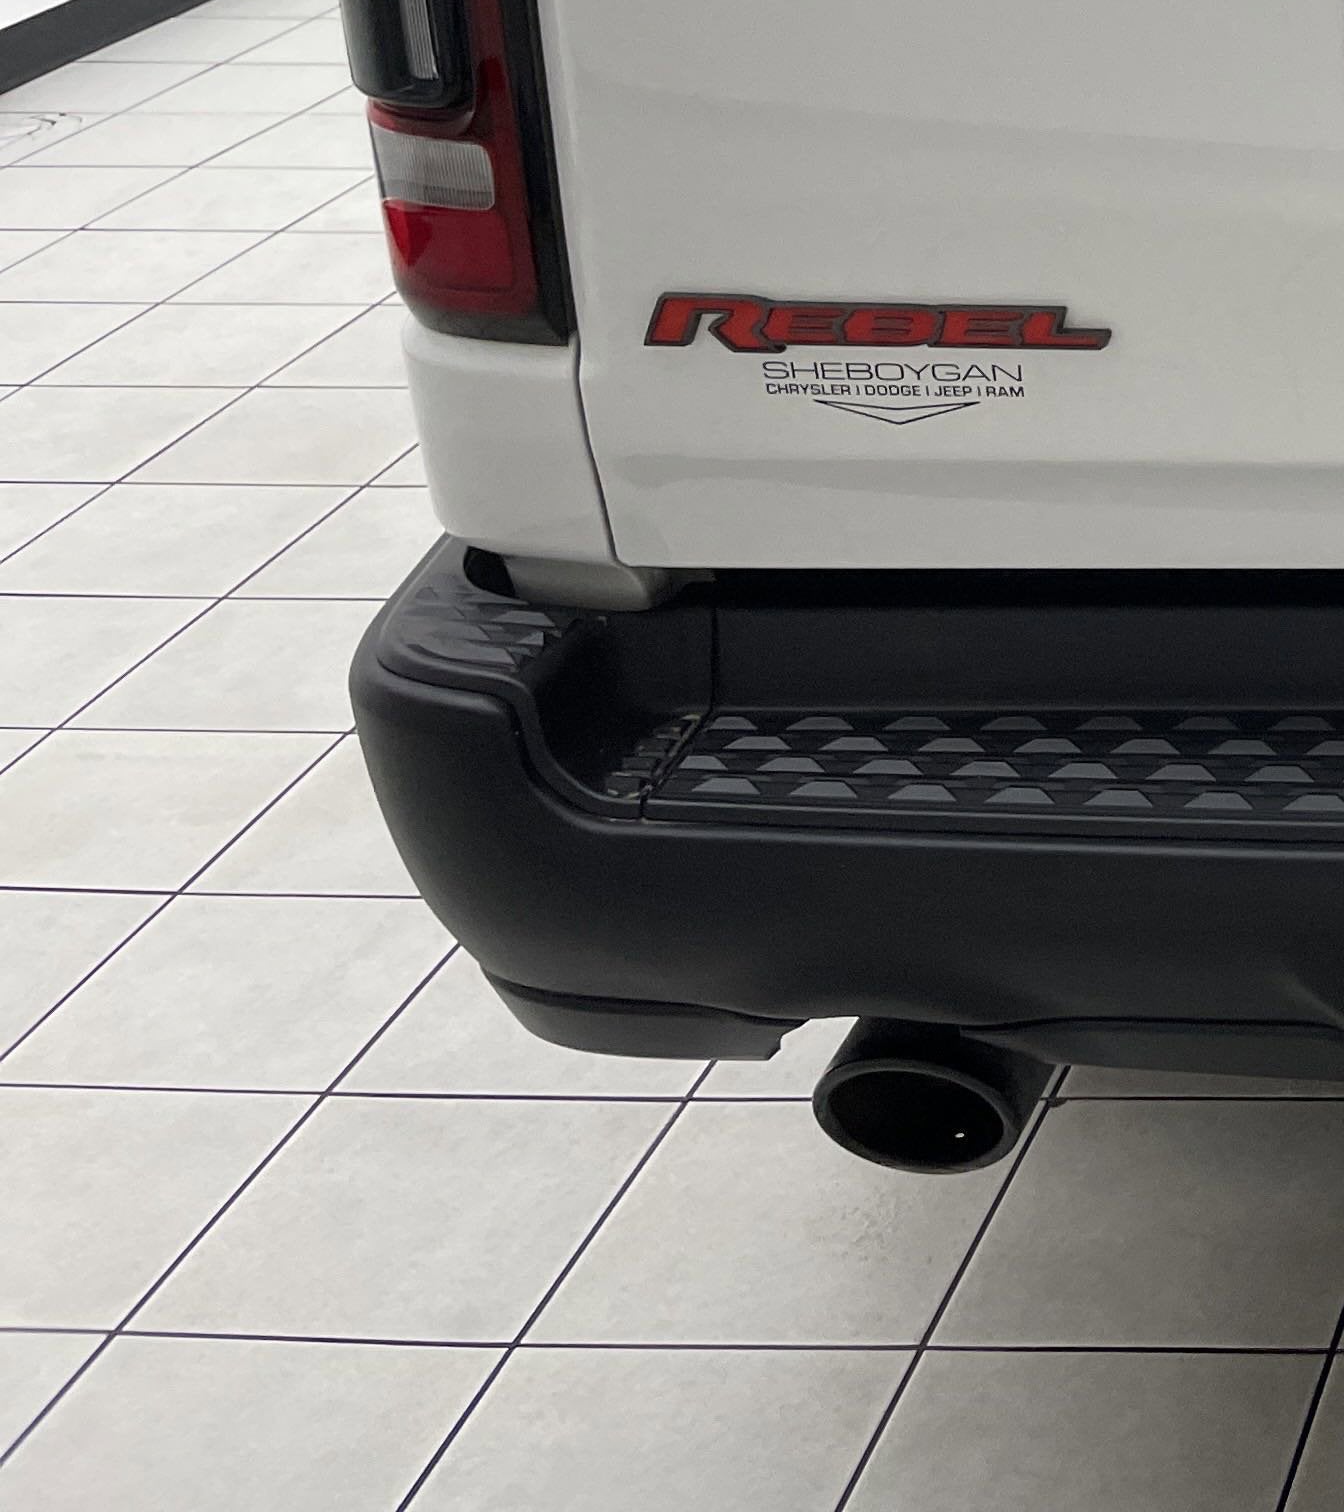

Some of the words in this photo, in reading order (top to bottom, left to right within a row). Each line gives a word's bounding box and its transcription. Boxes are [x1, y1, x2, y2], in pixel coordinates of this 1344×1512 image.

[645, 292, 1112, 353] REBEL
[762, 361, 1022, 382] SHEBOYGAN
[766, 383, 851, 396] CHRYSLER
[865, 384, 921, 397] DODGE
[934, 385, 972, 397] JEEP
[986, 385, 1025, 398] RAM
